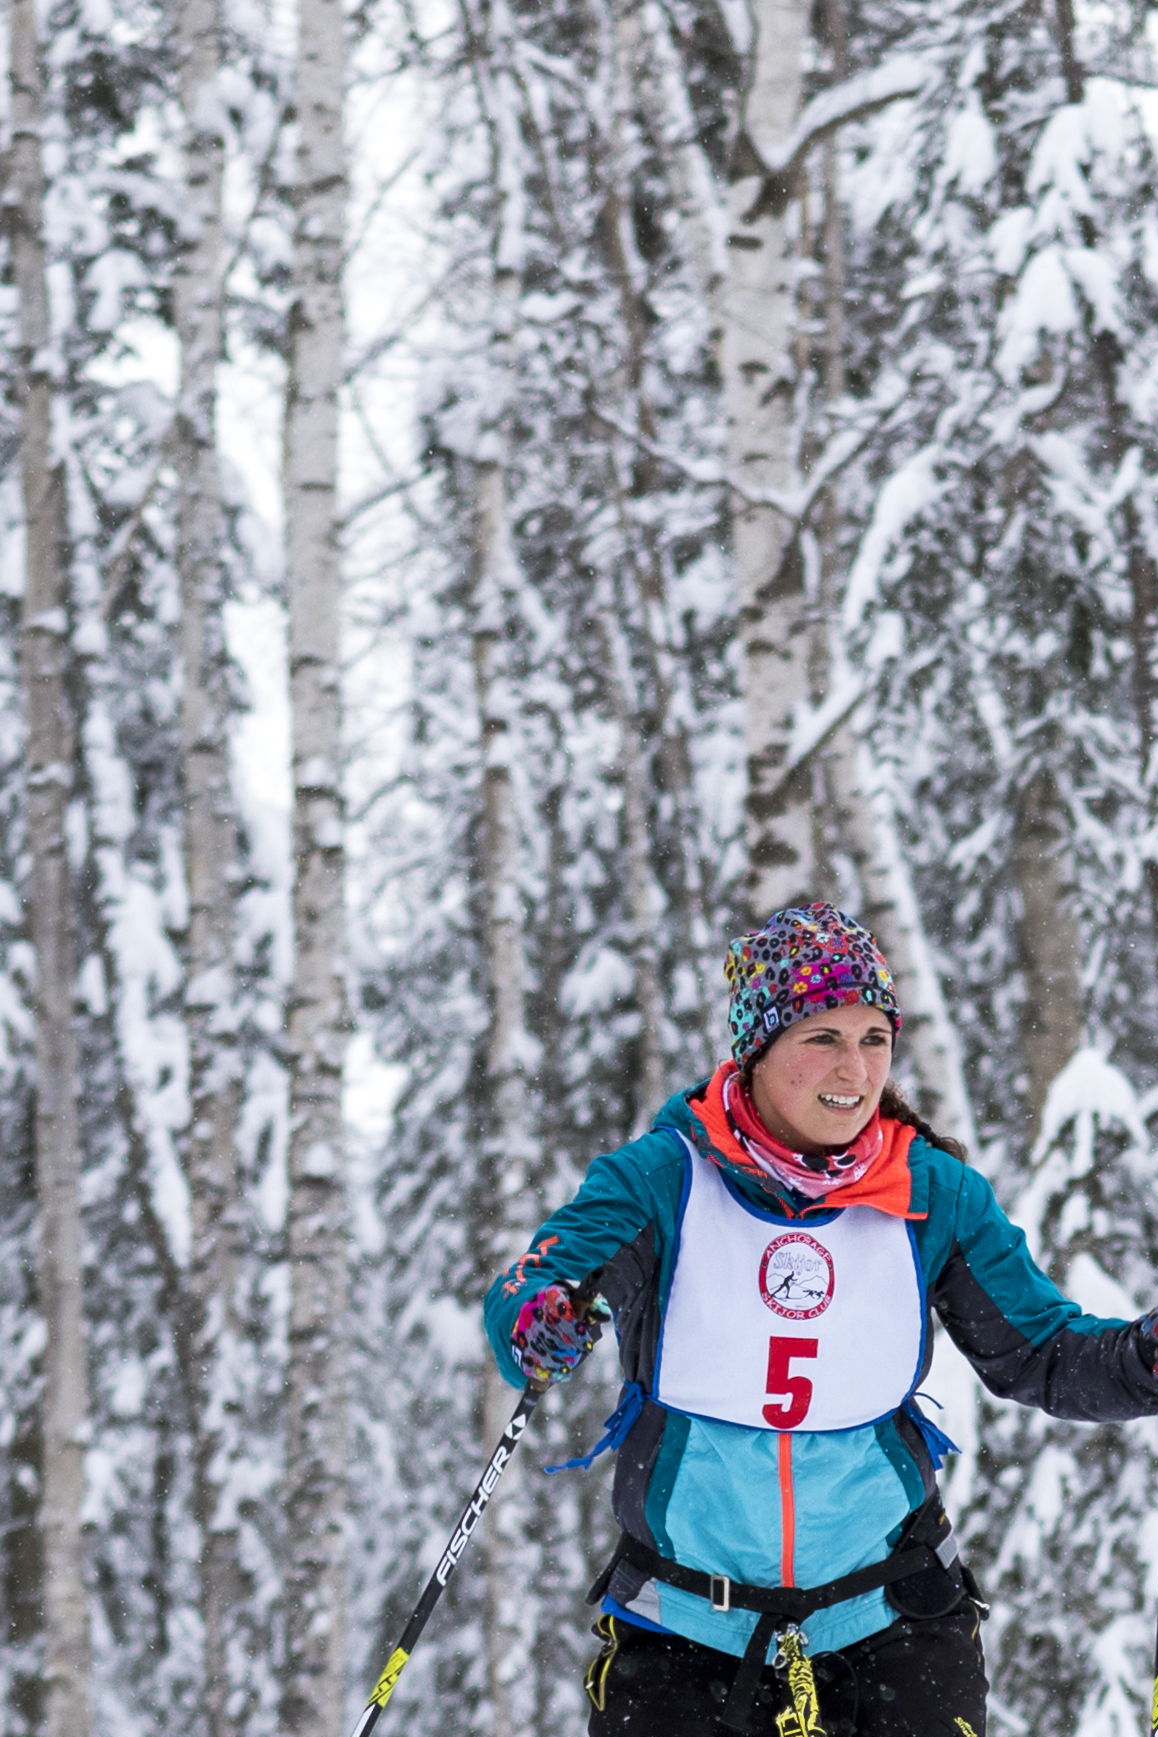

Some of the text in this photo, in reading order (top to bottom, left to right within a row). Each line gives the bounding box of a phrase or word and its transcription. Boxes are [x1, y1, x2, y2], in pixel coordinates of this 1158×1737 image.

[766, 1233, 832, 1264] ANCHORAGE
[773, 1251, 822, 1275] Skijor
[762, 1292, 832, 1320] SKIJOR CLUB
[762, 1335, 818, 1429] 5
[436, 1445, 511, 1586] FISCHER
